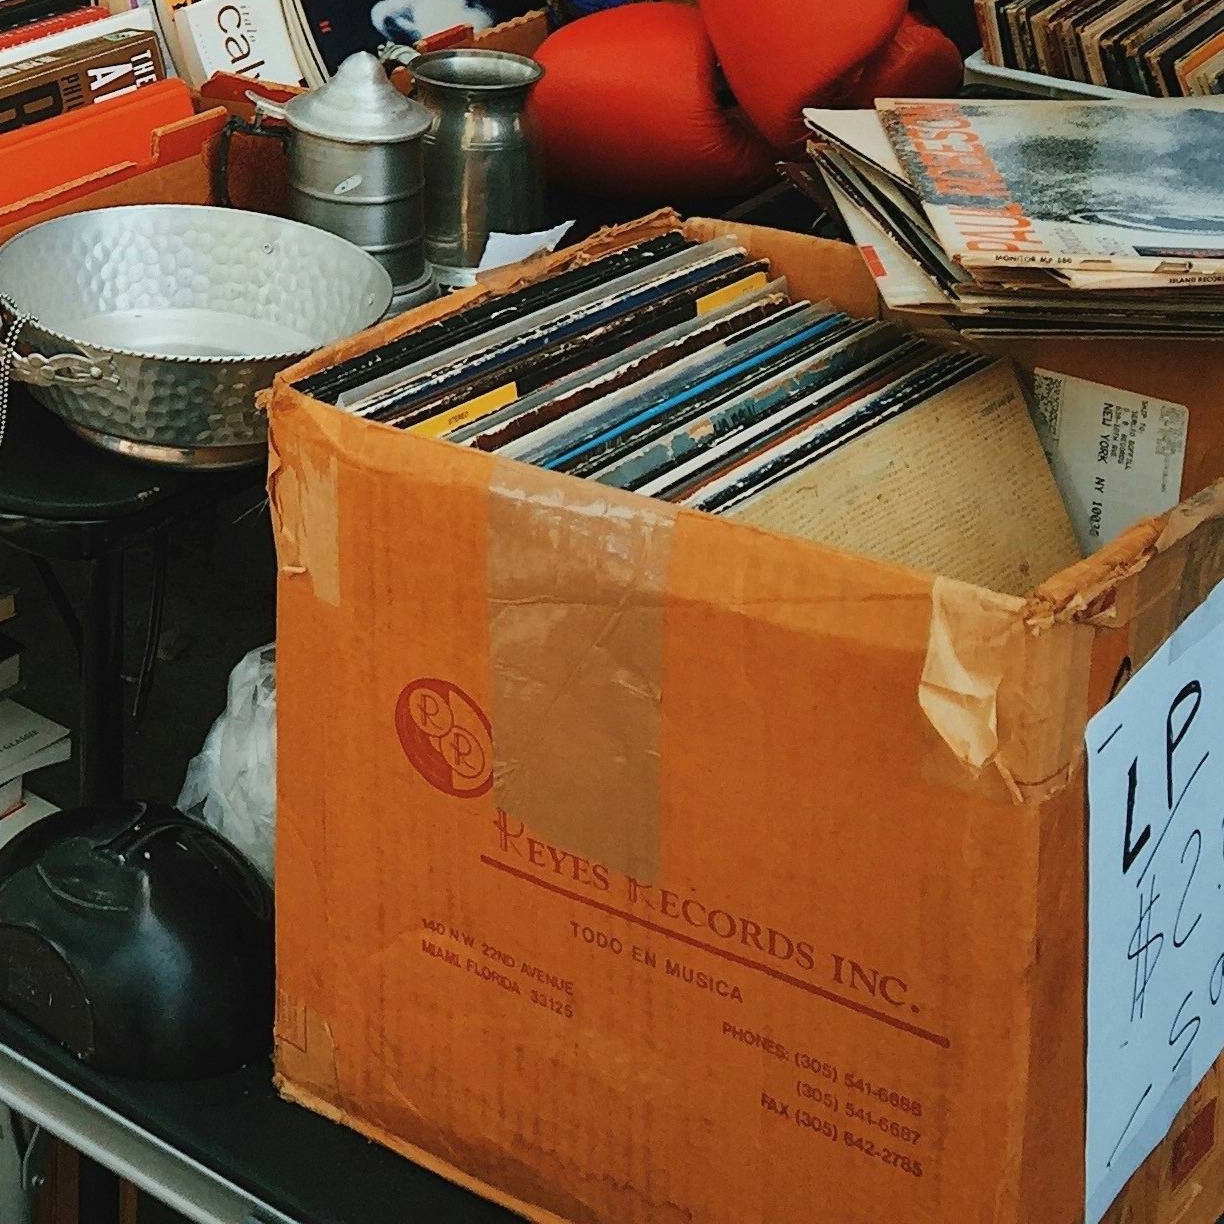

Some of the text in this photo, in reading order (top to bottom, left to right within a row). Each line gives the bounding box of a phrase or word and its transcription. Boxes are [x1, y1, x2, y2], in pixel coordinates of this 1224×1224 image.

[130, 49, 158, 89] THE
[948, 203, 1050, 254] PAUL
[1101, 402, 1114, 427] NEW
[1097, 433, 1111, 465] YORK
[1094, 476, 1106, 494] NY
[492, 805, 921, 1014] REYES RECORDS INC.
[466, 957, 523, 996] FLORIDA
[481, 941, 517, 969] 22ND
[520, 962, 575, 997] AVENUE
[570, 919, 745, 1004] TODO EN MUSICA
[794, 1049, 838, 1083] (305)
[796, 1078, 839, 1113] (305)
[760, 1090, 790, 1120] FAX
[794, 1108, 839, 1142] (305)
